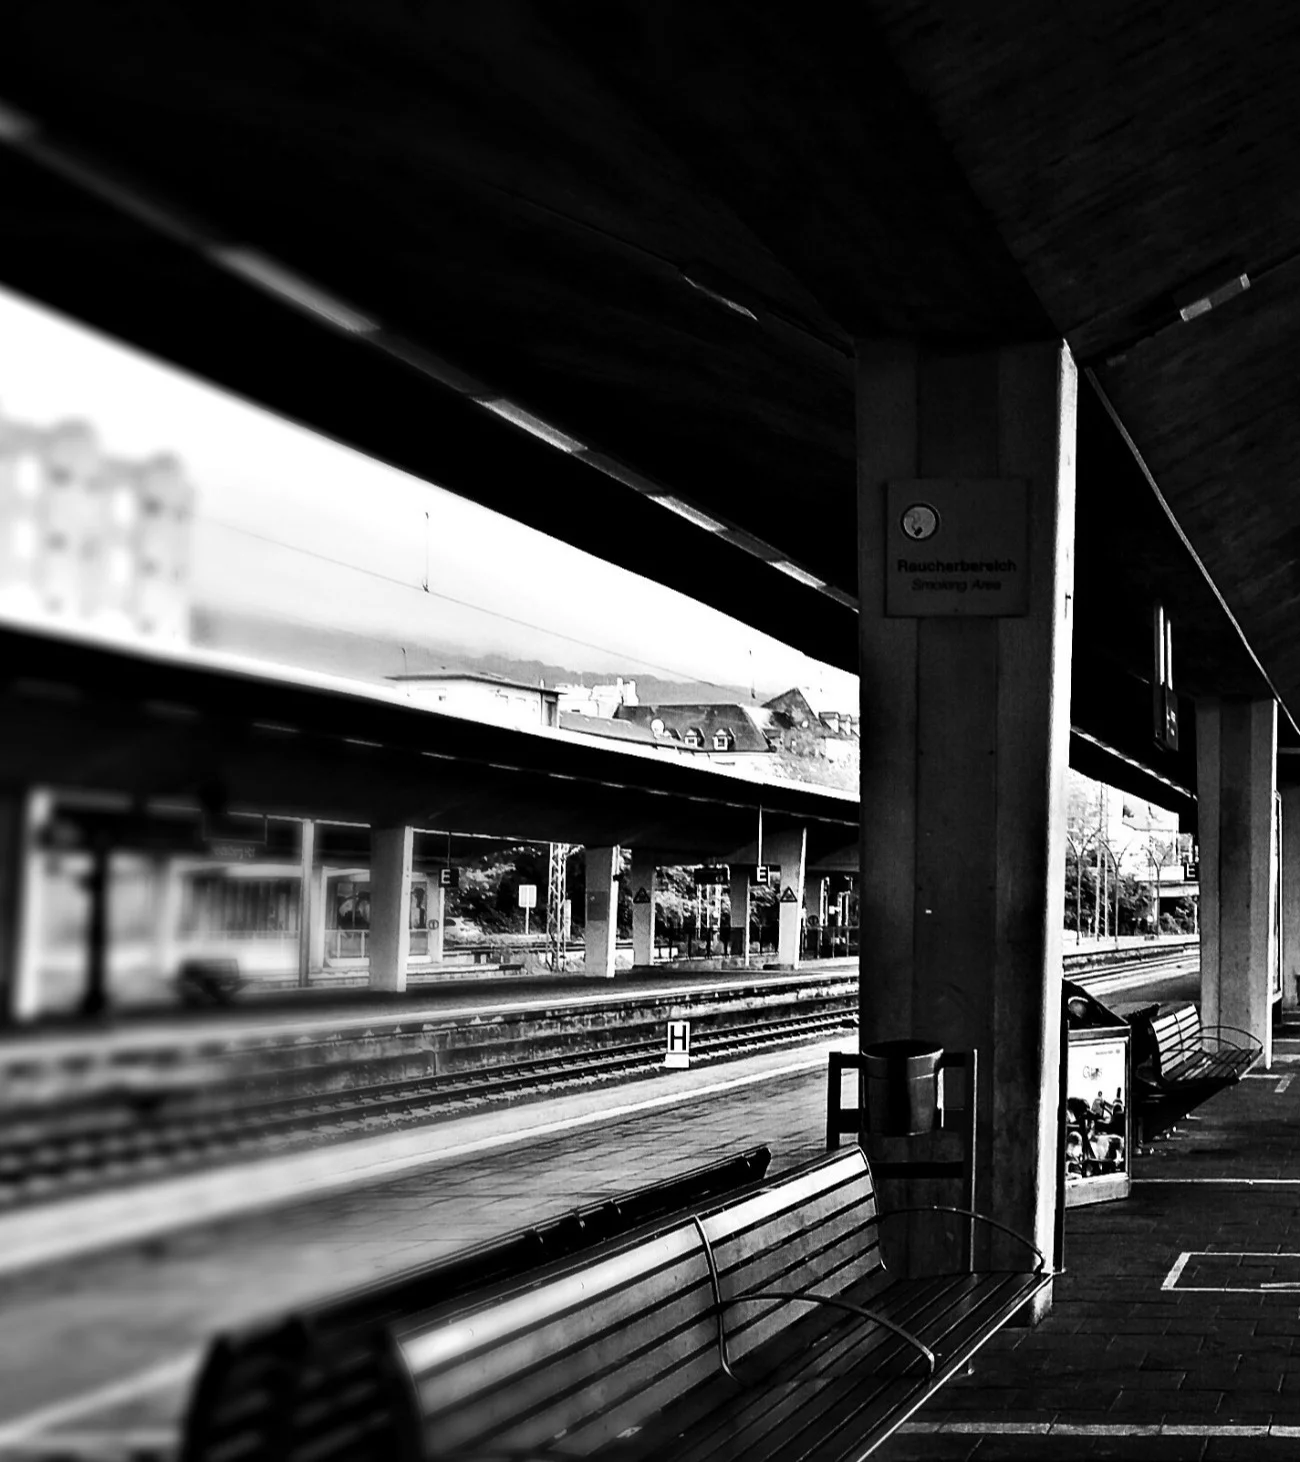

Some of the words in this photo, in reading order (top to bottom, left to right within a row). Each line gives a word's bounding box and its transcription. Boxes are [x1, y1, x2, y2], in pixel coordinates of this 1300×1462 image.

[897, 558, 1018, 573] Raucherbereich
[911, 578, 968, 593] Smoking
[972, 579, 1002, 591] Area
[441, 869, 451, 884] E
[756, 866, 767, 882] E
[1186, 862, 1196, 878] E
[670, 1024, 687, 1051] H
